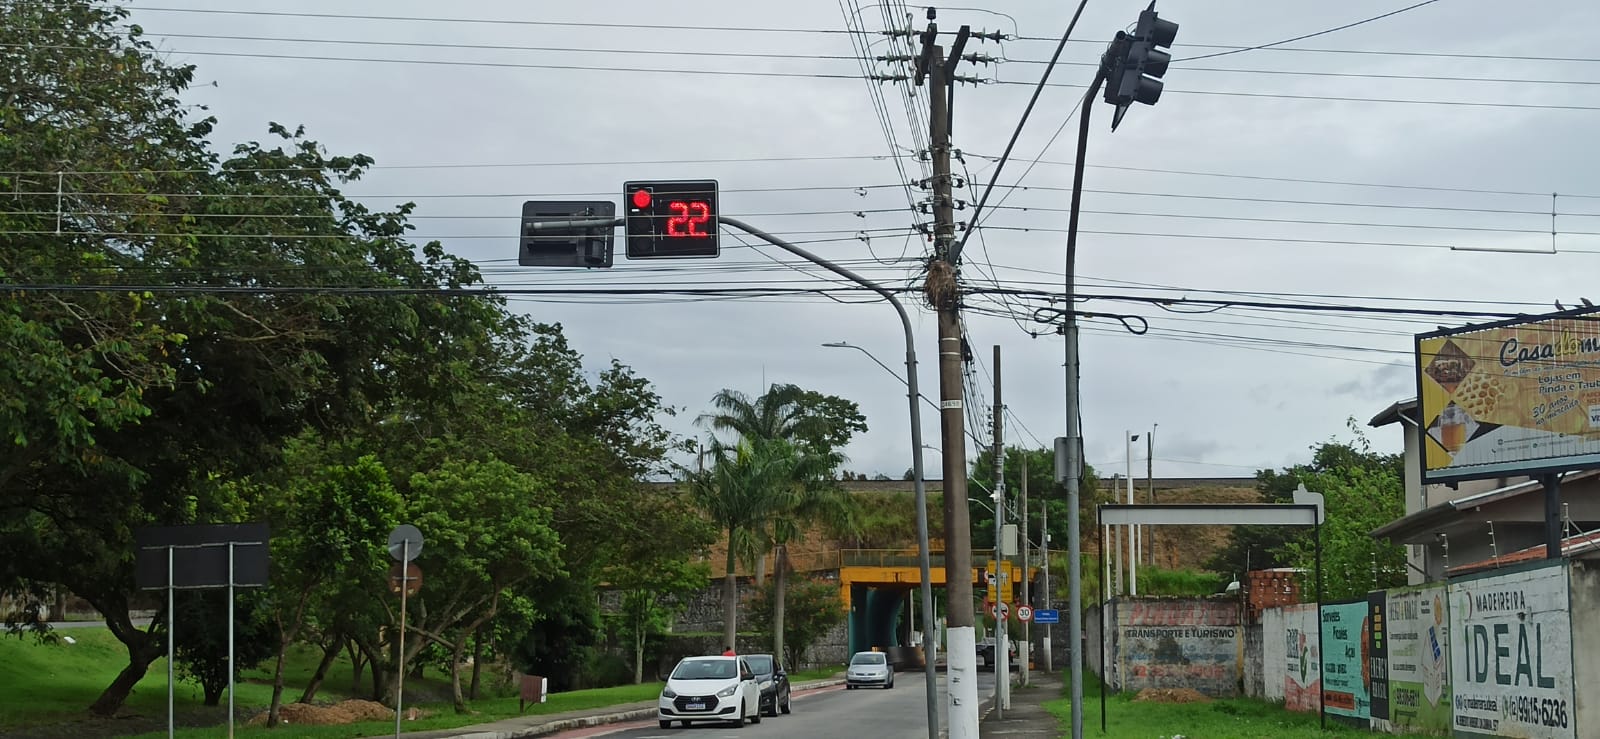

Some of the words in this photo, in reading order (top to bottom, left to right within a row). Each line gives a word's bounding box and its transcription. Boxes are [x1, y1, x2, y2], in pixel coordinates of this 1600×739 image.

[668, 201, 709, 237] 22
[1538, 374, 1563, 384] Lojas
[1566, 372, 1581, 380] em
[1539, 384, 1566, 394] Pinda
[1532, 403, 1546, 418] 30
[1548, 395, 1568, 409] anos
[1546, 399, 1579, 419] mercado
[1475, 590, 1526, 612] MADEIREIRA
[1019, 609, 1030, 617] 30
[1322, 609, 1341, 622] Sorvetes
[1127, 629, 1183, 638] TRANSPORTE
[1185, 630, 1190, 638] E
[1191, 629, 1235, 638] TURISMO
[1464, 622, 1556, 689] IDEAL
[1370, 656, 1387, 680] ENERGY
[1372, 680, 1387, 699] BRASIL
